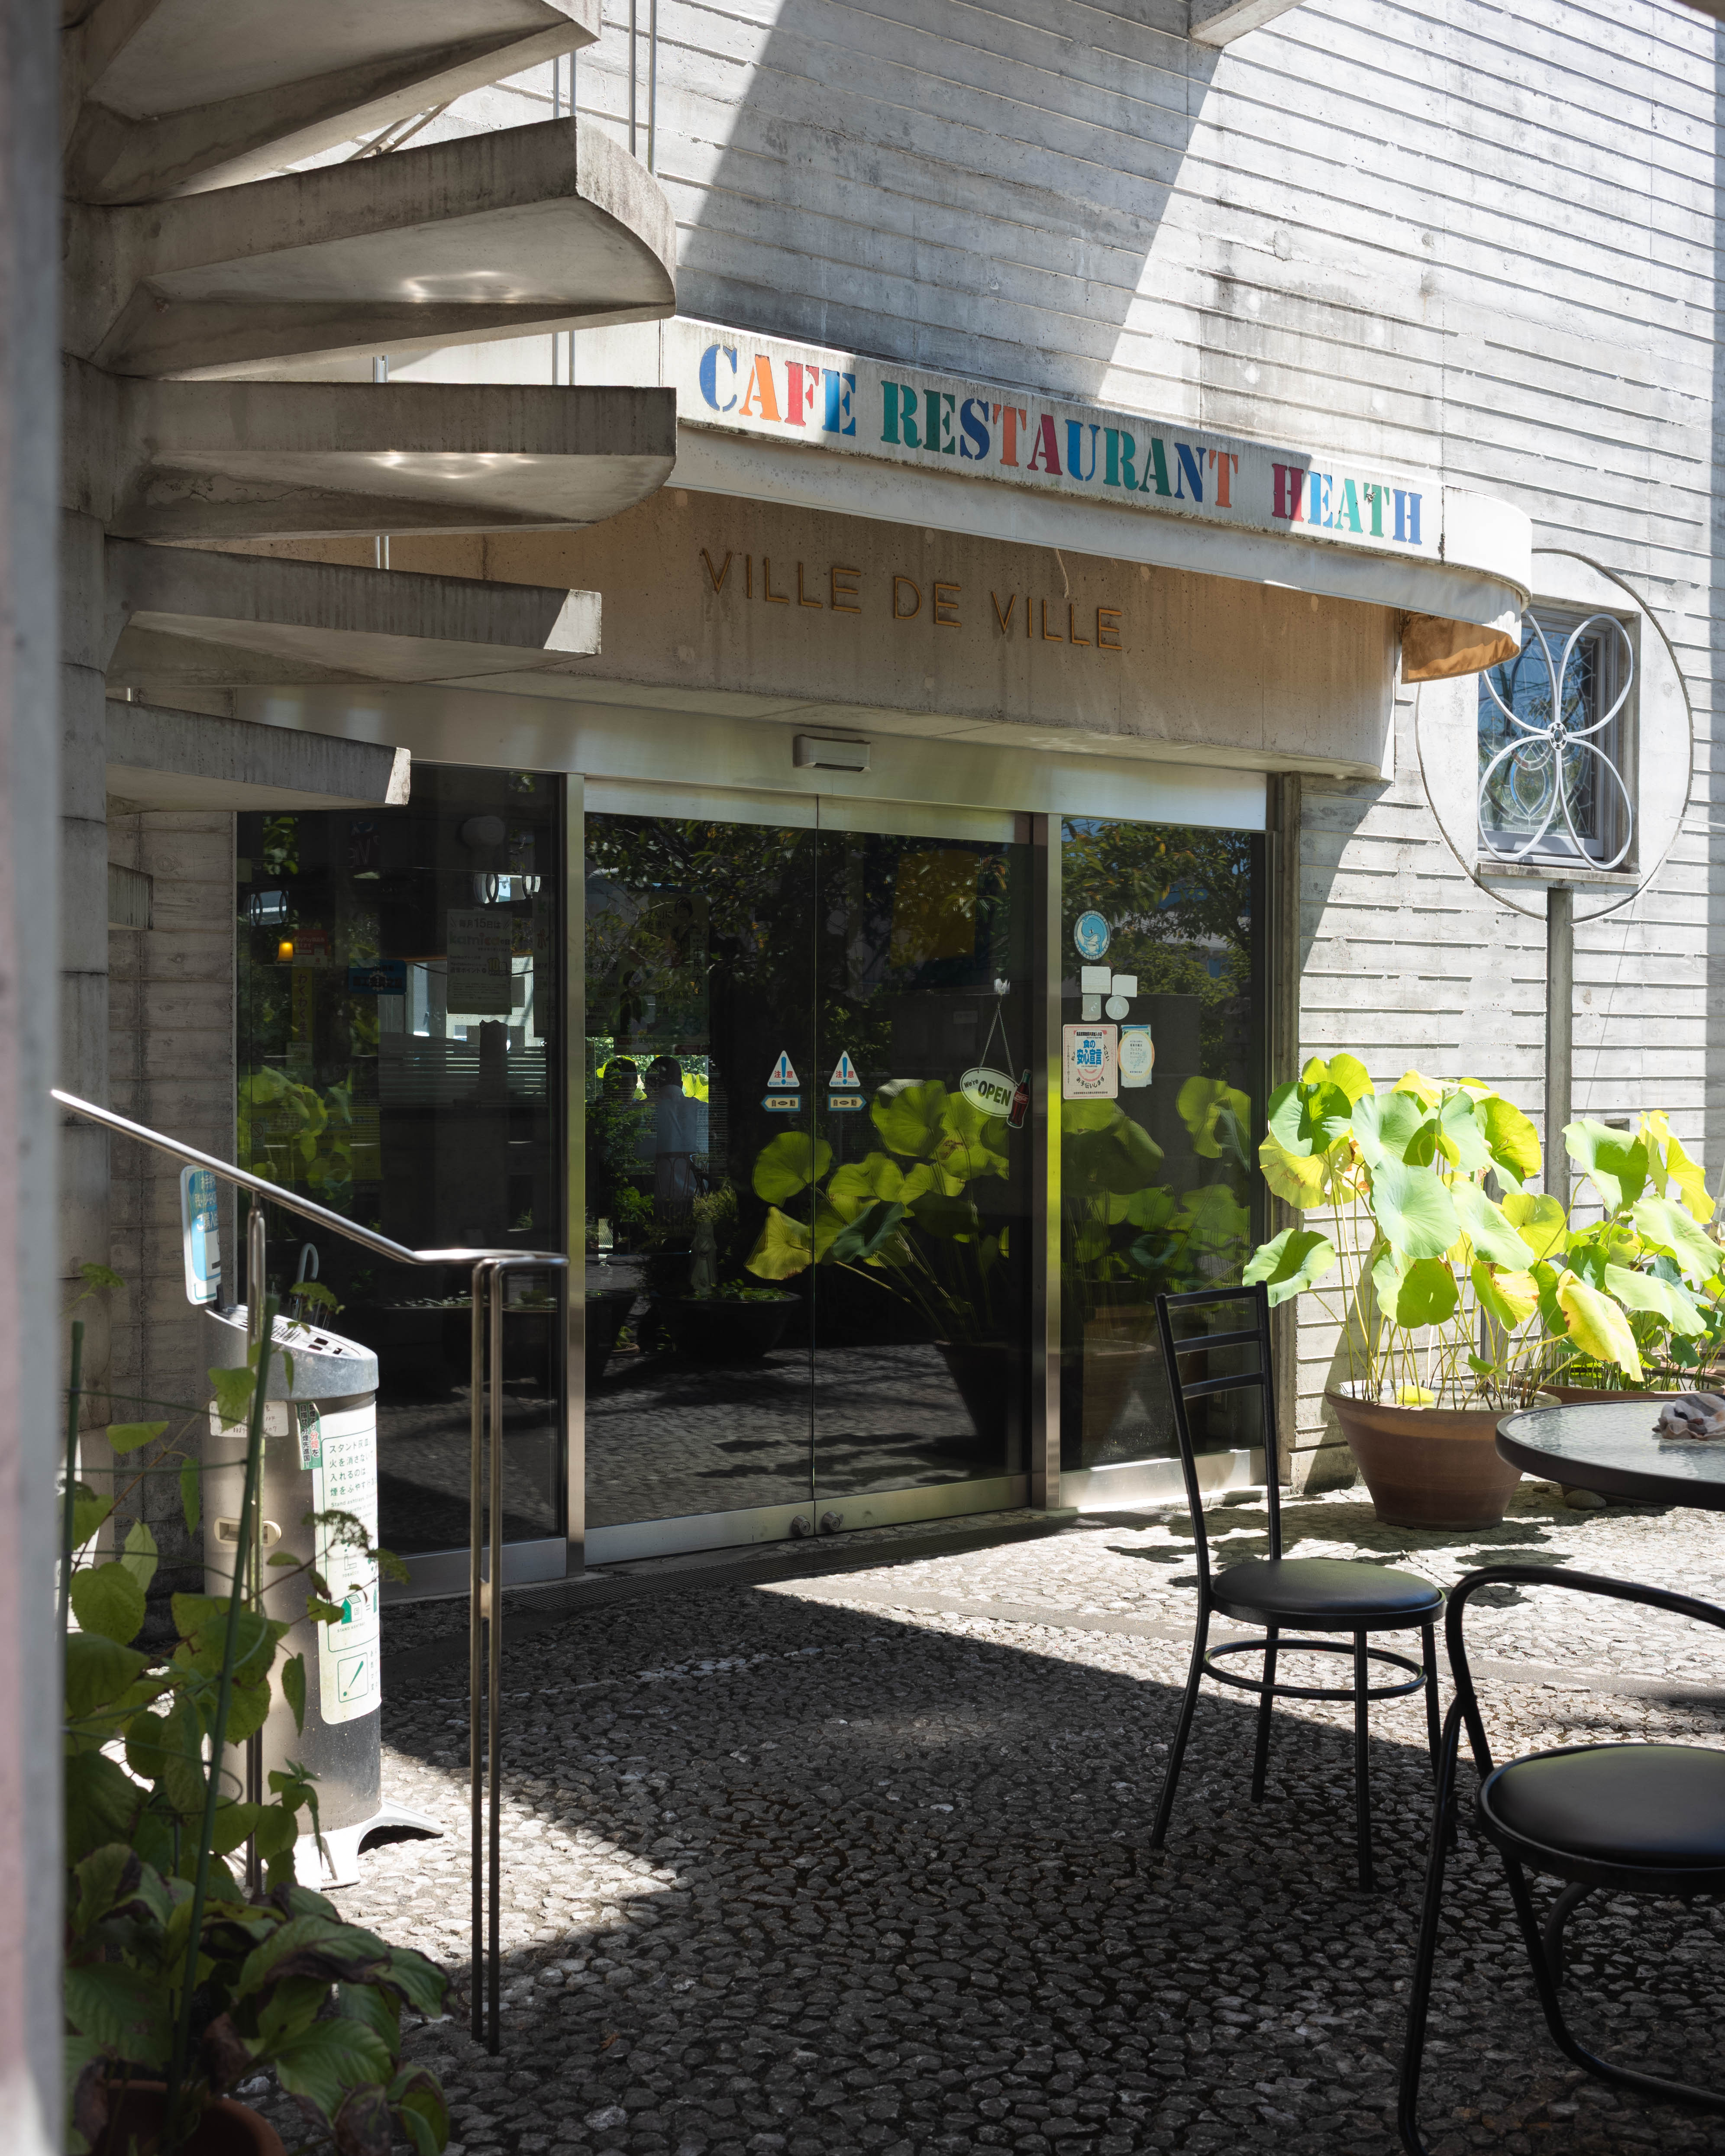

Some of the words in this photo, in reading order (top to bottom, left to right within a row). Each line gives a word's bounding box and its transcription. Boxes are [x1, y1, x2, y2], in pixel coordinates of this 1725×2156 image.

[699, 343, 856, 437] CAFE
[880, 379, 1239, 508] RESTAURANT
[1271, 463, 1422, 545] HEATH
[701, 548, 862, 614] VILLE
[893, 577, 962, 628] DE
[992, 591, 1123, 651] VILLE
[459, 918, 501, 929] 毎月15日は
[1083, 1039, 1095, 1049] 食の
[1077, 1049, 1102, 1065] 安心宣言
[1076, 1076, 1105, 1088] お手伝いします
[964, 1079, 979, 1088] We're
[978, 1081, 1011, 1107] OPEN
[309, 1404, 320, 1457] 禁煙より分煙を
[331, 1499, 346, 1507] Stand
